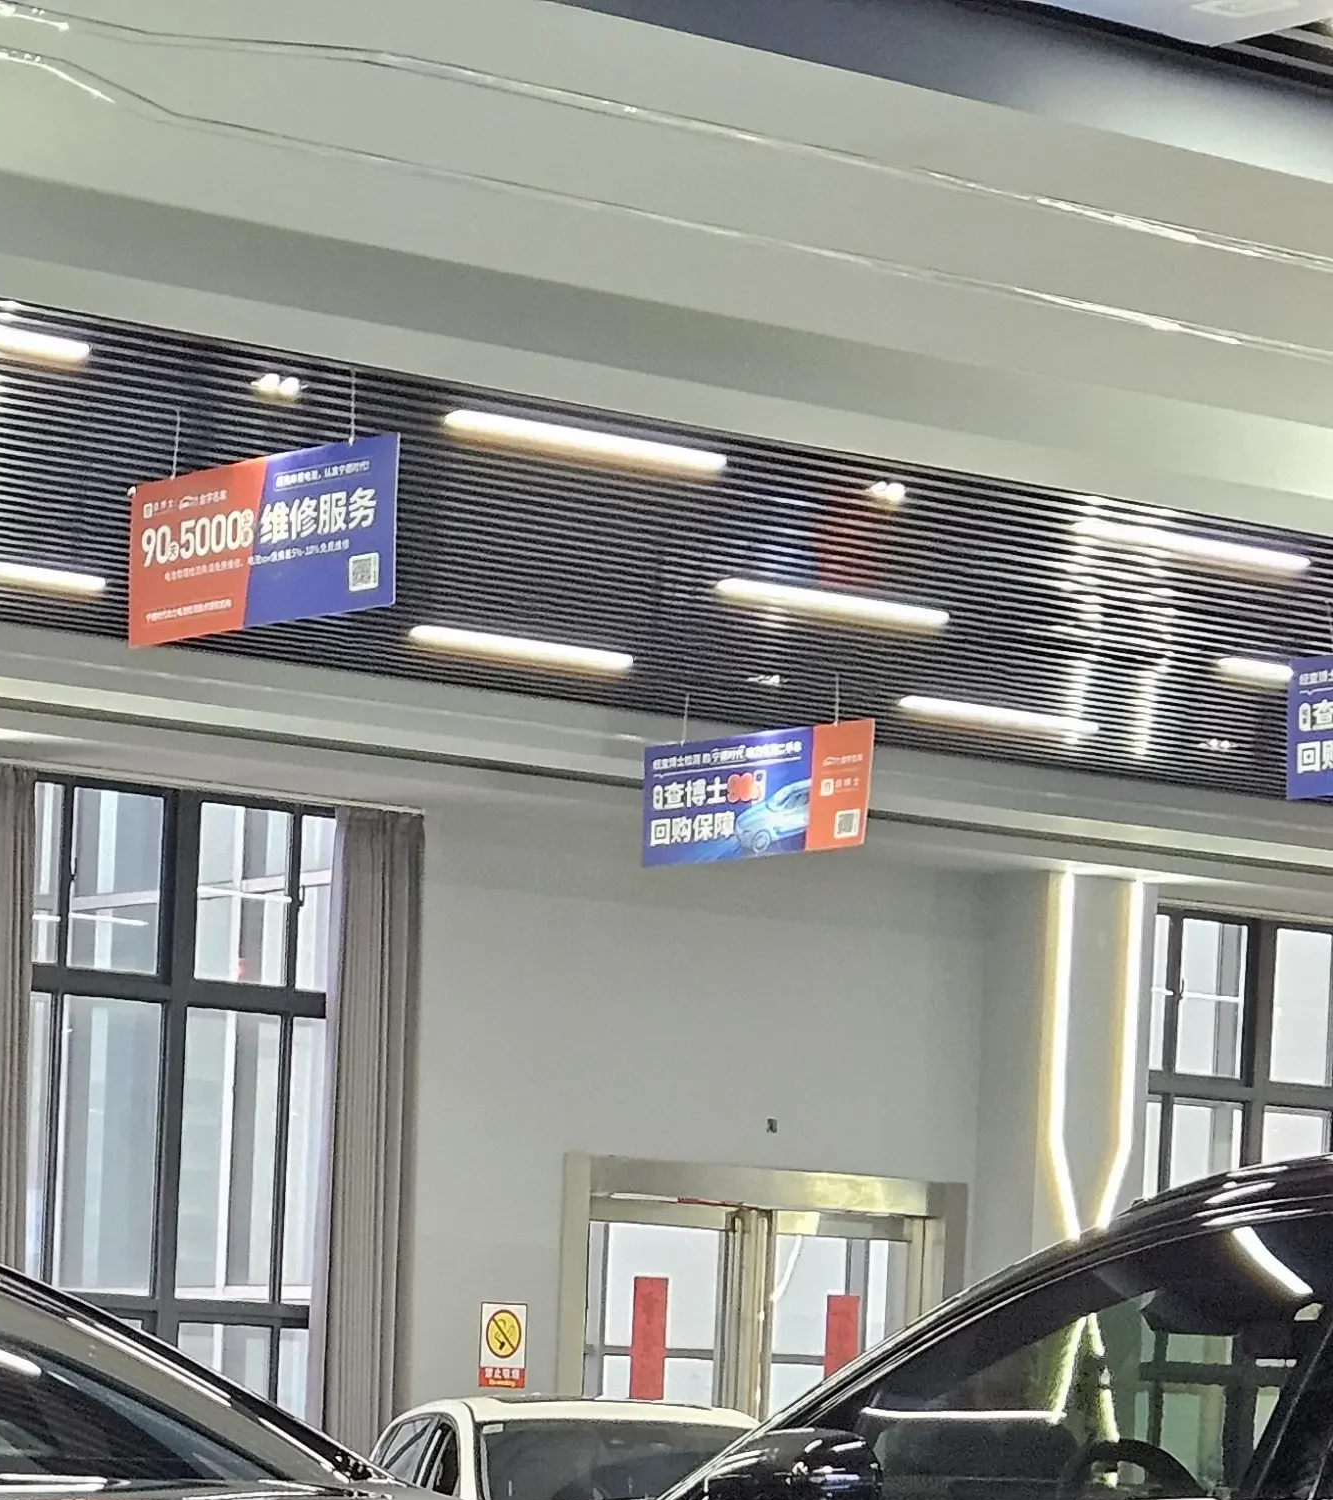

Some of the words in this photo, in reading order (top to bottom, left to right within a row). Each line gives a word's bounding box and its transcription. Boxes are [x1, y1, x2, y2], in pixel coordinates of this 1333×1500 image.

[260, 487, 377, 544] 维修服务
[650, 811, 735, 846] 回购保障
